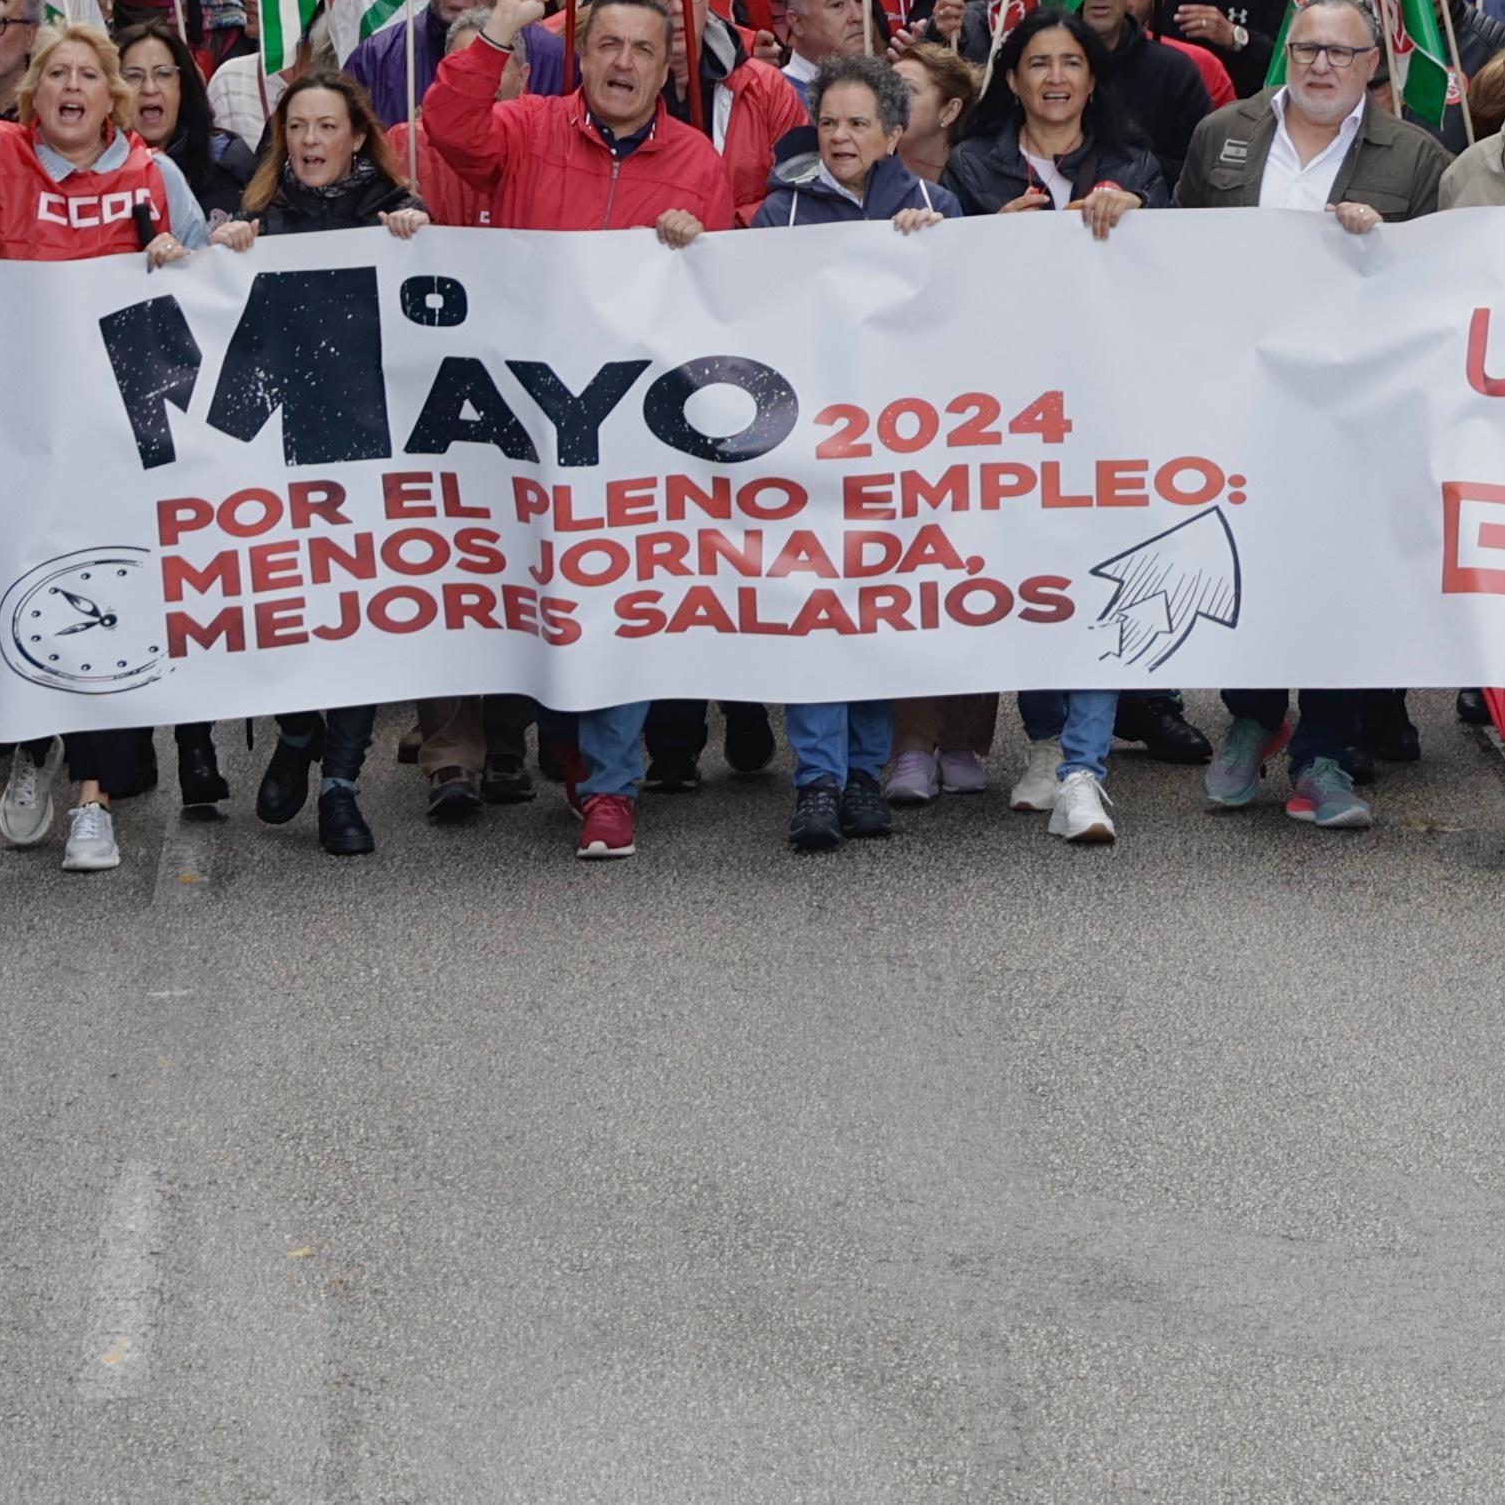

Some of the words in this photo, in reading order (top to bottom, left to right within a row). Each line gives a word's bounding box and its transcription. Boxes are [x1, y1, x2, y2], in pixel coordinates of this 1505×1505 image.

[813, 390, 1073, 460] 2024
[155, 479, 353, 547] POR
[381, 470, 492, 521] EL
[510, 474, 809, 533] PLENO
[843, 455, 1248, 521] EMPLEO:
[160, 527, 507, 602] MENOS
[528, 523, 986, 588] JORNADA,
[164, 581, 582, 658] MEJORES
[613, 574, 1076, 639] SALARIOS
